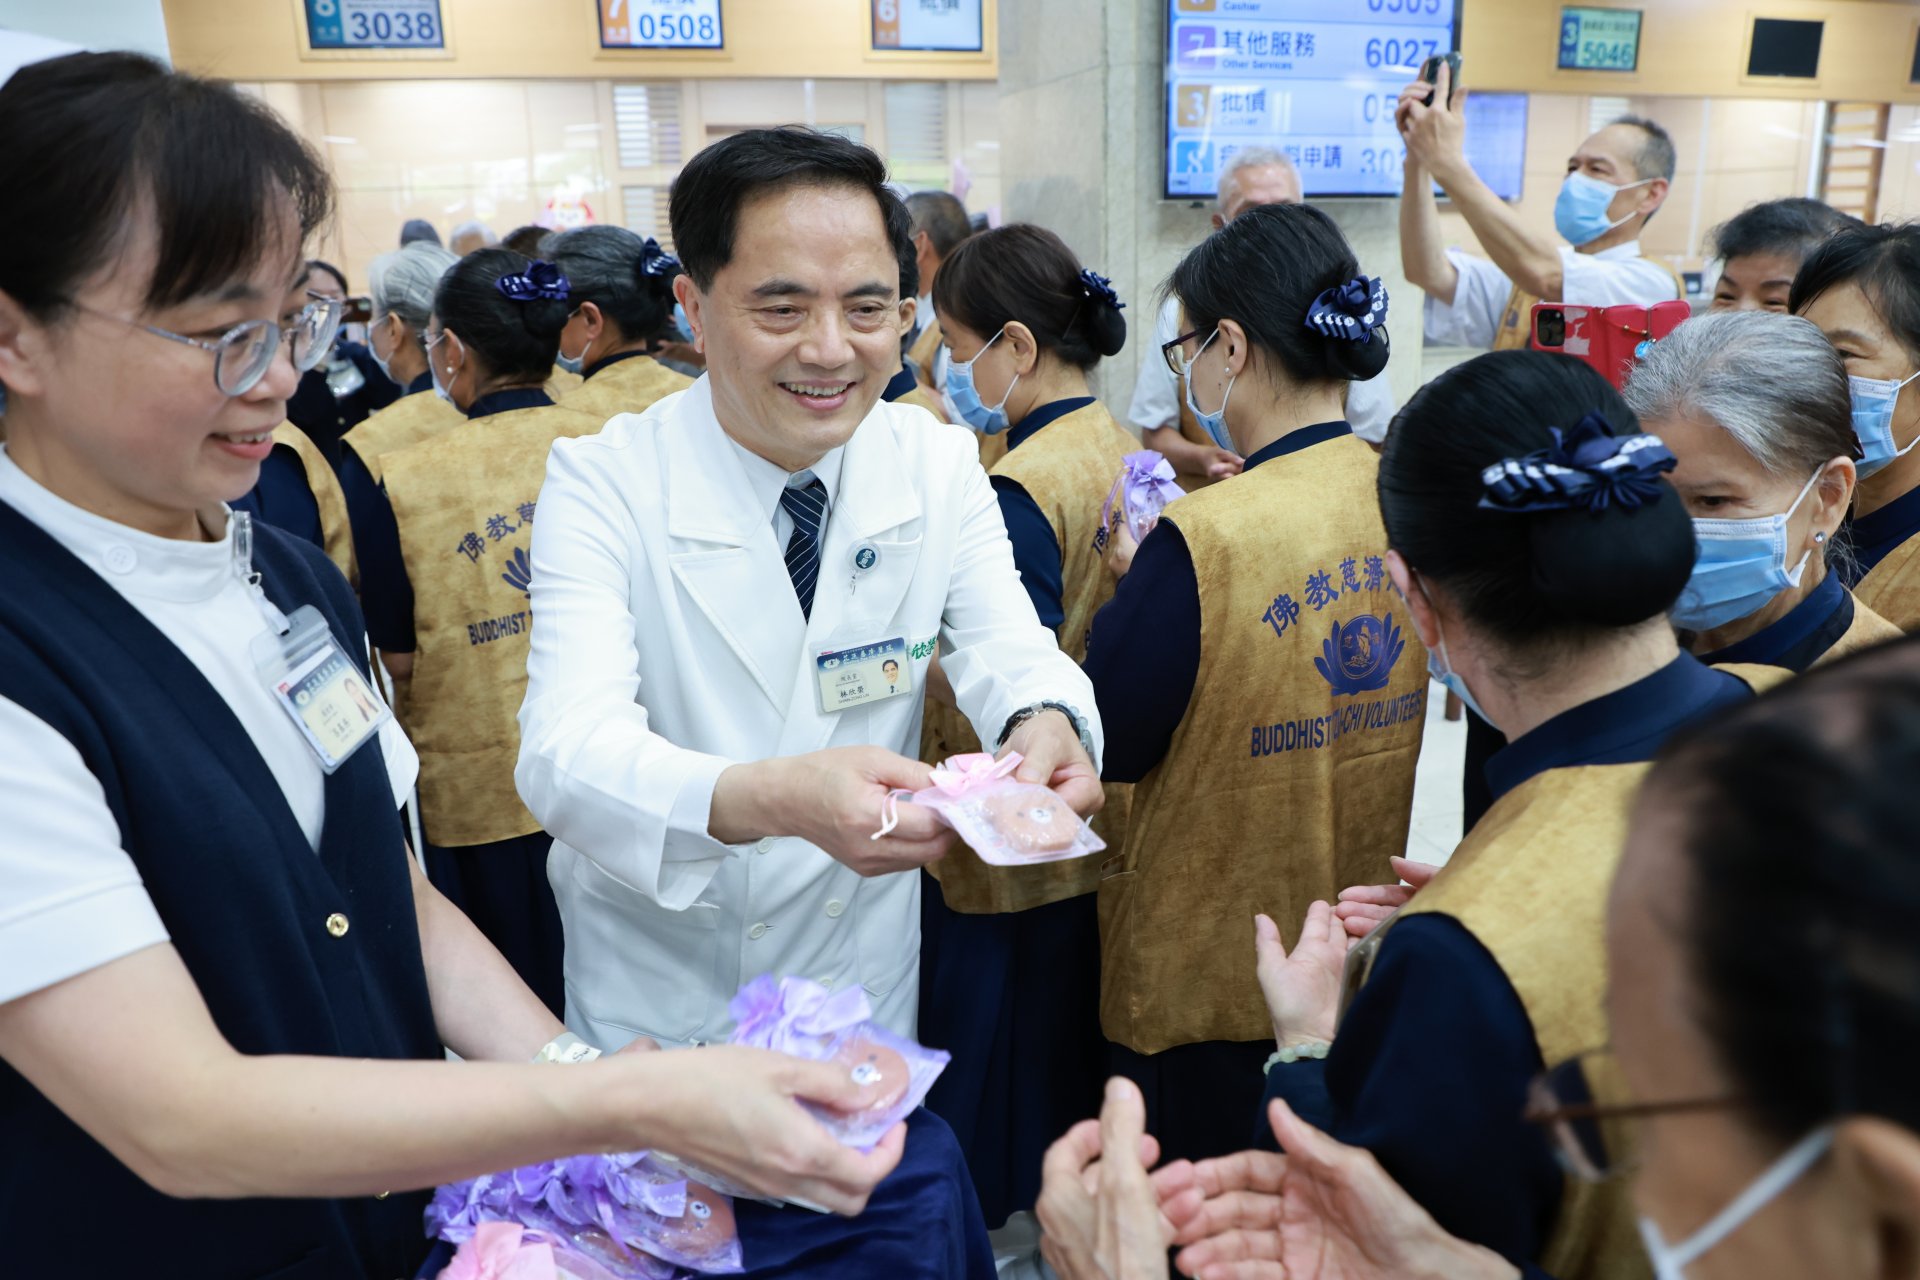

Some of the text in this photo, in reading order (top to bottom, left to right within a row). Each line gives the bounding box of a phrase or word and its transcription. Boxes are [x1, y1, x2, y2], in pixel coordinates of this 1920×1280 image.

[351, 12, 435, 40] 3038
[639, 14, 714, 40] 0508
[1563, 22, 1577, 46] 3
[1222, 29, 1316, 57] 其他服務
[1366, 38, 1438, 68] 6027
[1583, 41, 1633, 66] 5046
[1222, 60, 1292, 70] Other Services
[1186, 91, 1205, 121] 3
[467, 611, 527, 646] BUDDHIST
[1250, 715, 1332, 758] BUDDHIST
[1332, 703, 1364, 739] -CHI
